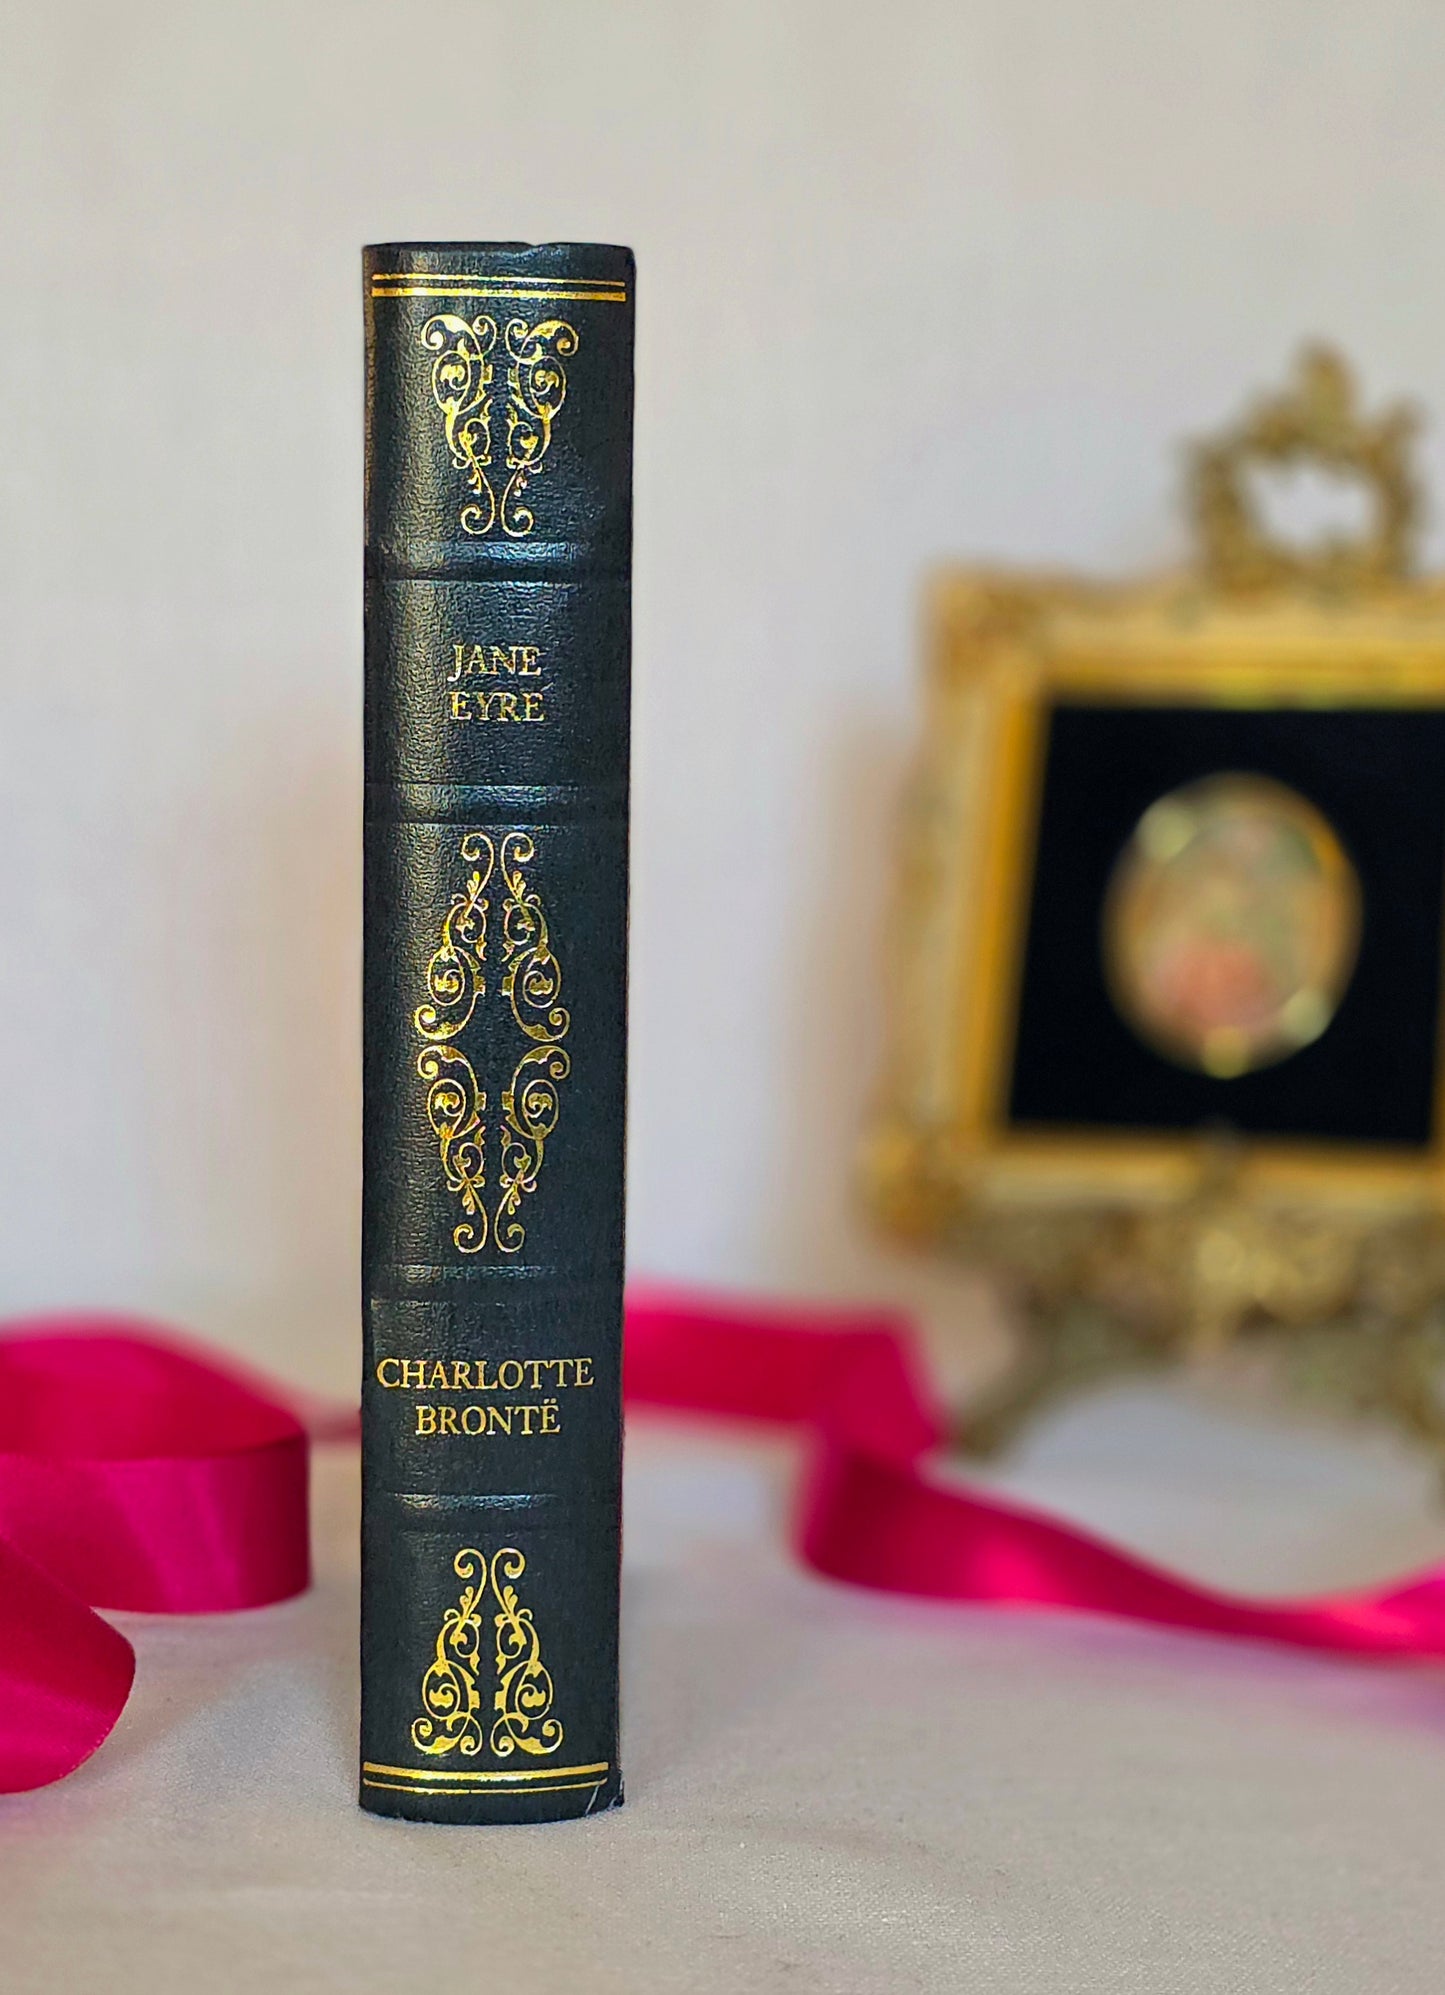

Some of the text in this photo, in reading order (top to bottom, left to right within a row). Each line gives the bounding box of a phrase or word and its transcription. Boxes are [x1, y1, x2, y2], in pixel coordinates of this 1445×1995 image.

[447, 644, 542, 682] JANE
[449, 691, 545, 722] EYRE
[376, 1357, 595, 1390] CHARLOTTE
[415, 1398, 562, 1436] BRONTË
